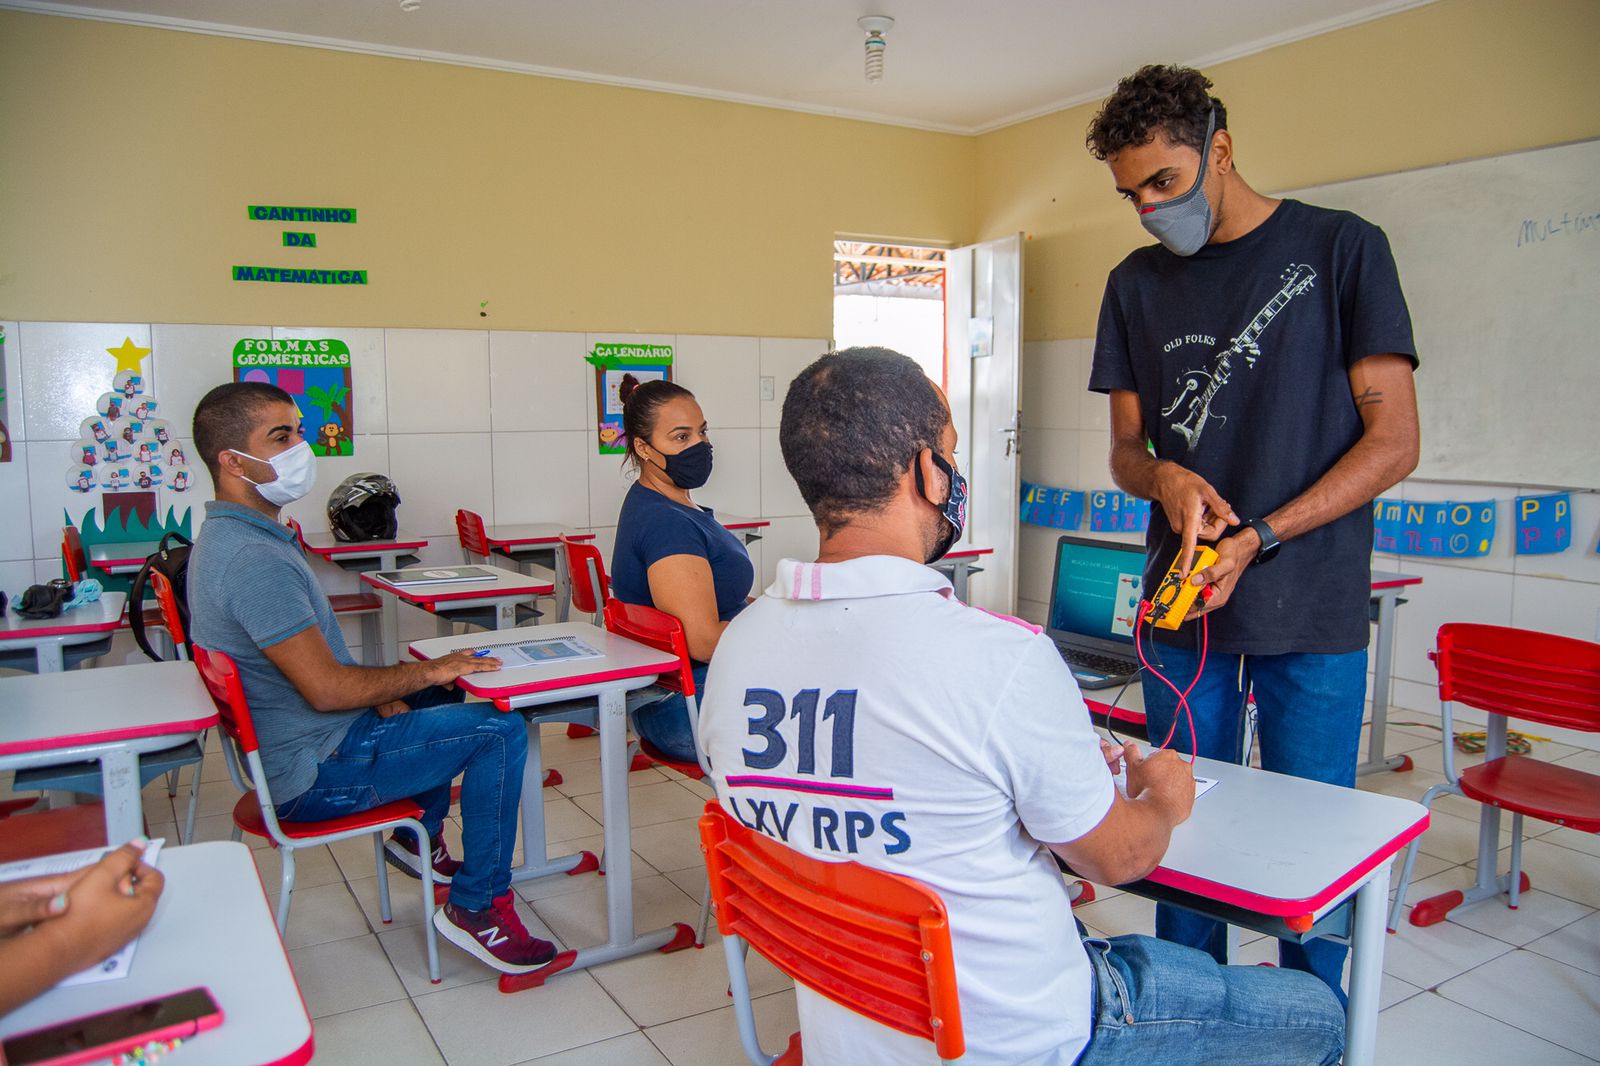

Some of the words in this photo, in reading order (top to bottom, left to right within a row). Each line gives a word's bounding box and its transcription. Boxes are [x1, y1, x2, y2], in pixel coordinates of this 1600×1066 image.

[254, 206, 351, 223] CANTINHO
[286, 233, 313, 247] DA
[244, 340, 330, 352] FORMAS
[596, 344, 672, 358] CALENDÁRIO
[1163, 337, 1183, 353] OLD
[1185, 334, 1217, 346] FOLKS
[237, 350, 349, 365] GEOMÉTRICAS
[1036, 487, 1047, 504] E
[1060, 492, 1072, 507] F
[1093, 492, 1106, 508] G
[1406, 504, 1425, 525] N
[1451, 505, 1472, 526] O
[1522, 500, 1540, 521] P
[741, 687, 859, 779] 311
[729, 796, 799, 842] LXV
[812, 806, 912, 856] RPS
